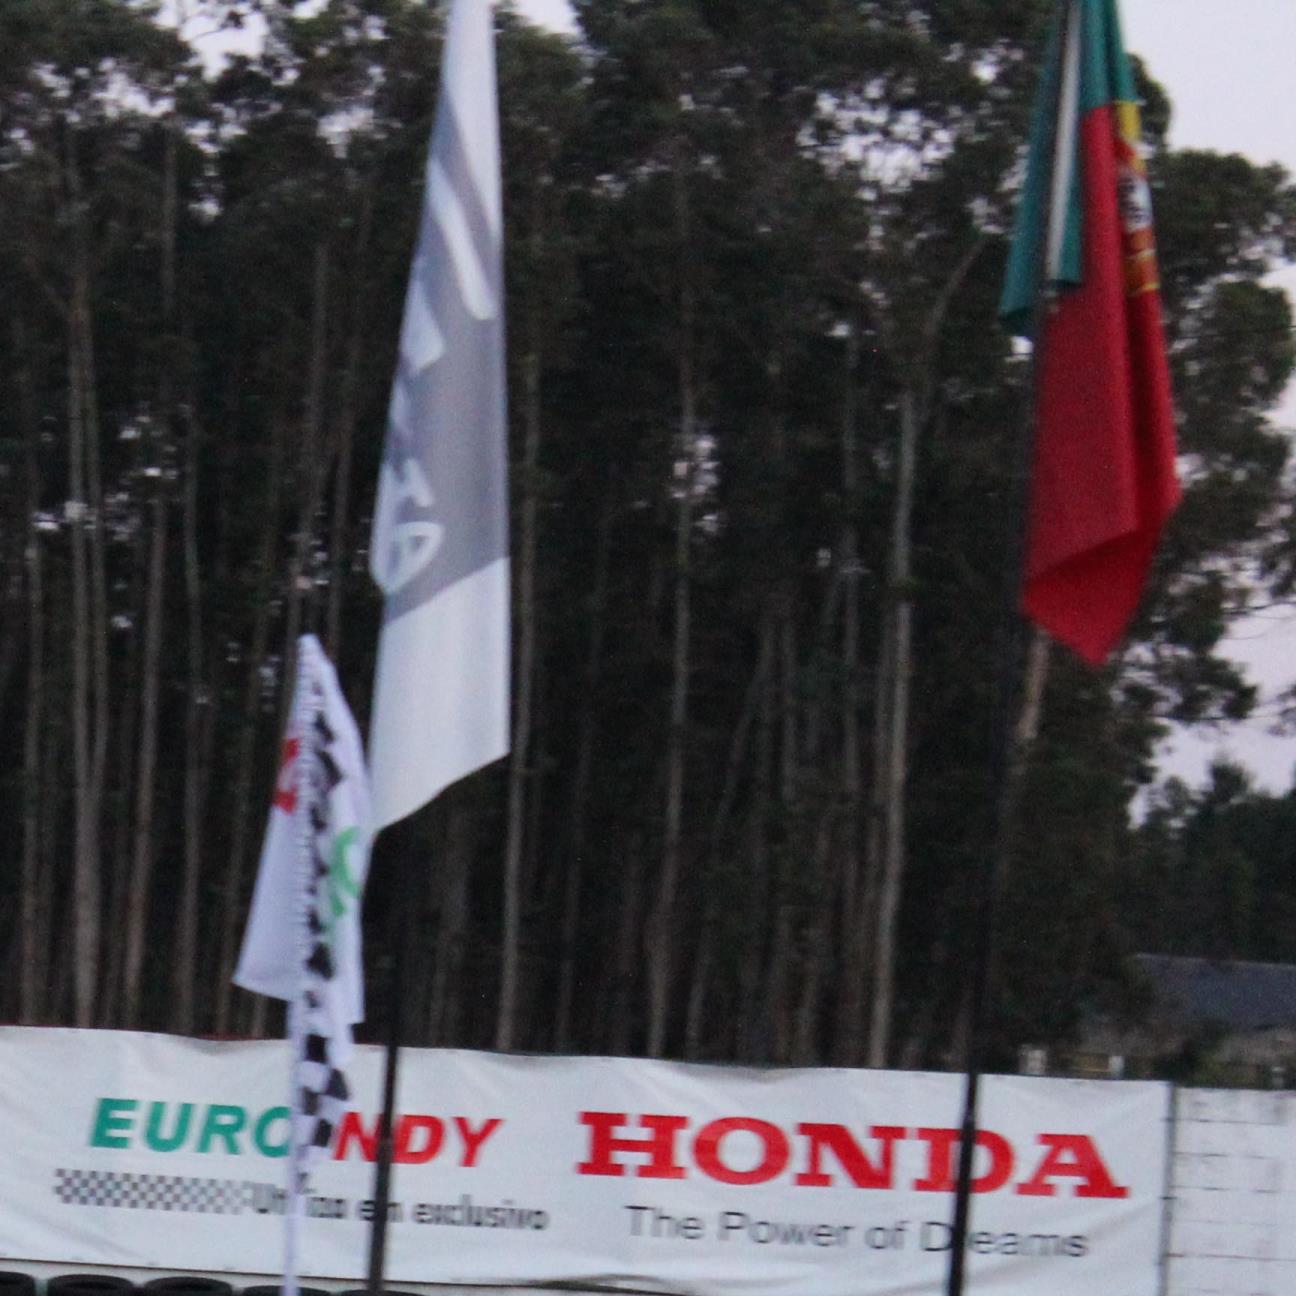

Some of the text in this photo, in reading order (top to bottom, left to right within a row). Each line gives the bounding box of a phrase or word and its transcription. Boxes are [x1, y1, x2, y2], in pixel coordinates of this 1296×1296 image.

[88, 1097, 503, 1168] EURONDY
[576, 1111, 1129, 1199] HONDA
[411, 1194, 551, 1231] exclusivo
[623, 1204, 1089, 1258] The Power of Deams
